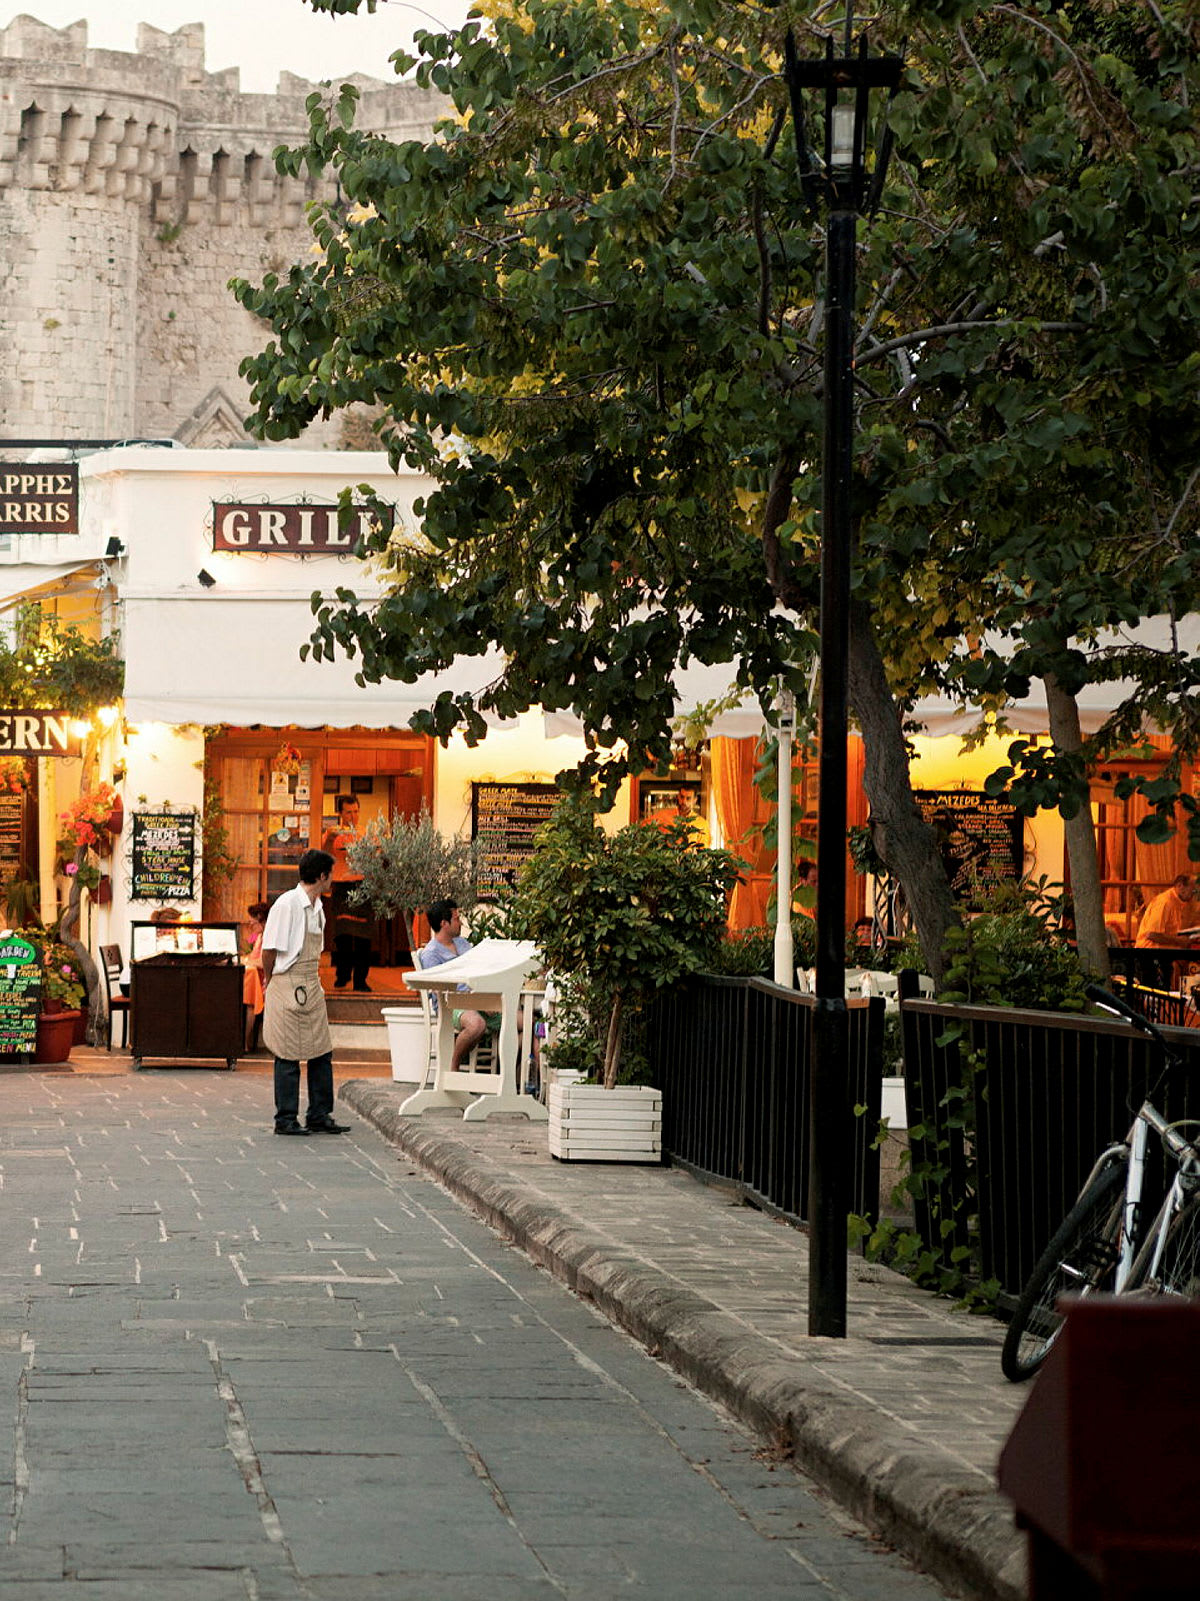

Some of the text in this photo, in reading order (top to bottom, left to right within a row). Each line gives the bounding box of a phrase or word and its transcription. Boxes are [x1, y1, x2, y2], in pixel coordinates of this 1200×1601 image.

[936, 795, 981, 805] MEZEDES
[22, 1020, 36, 1029] PITA
[15, 1042, 37, 1054] MENU
